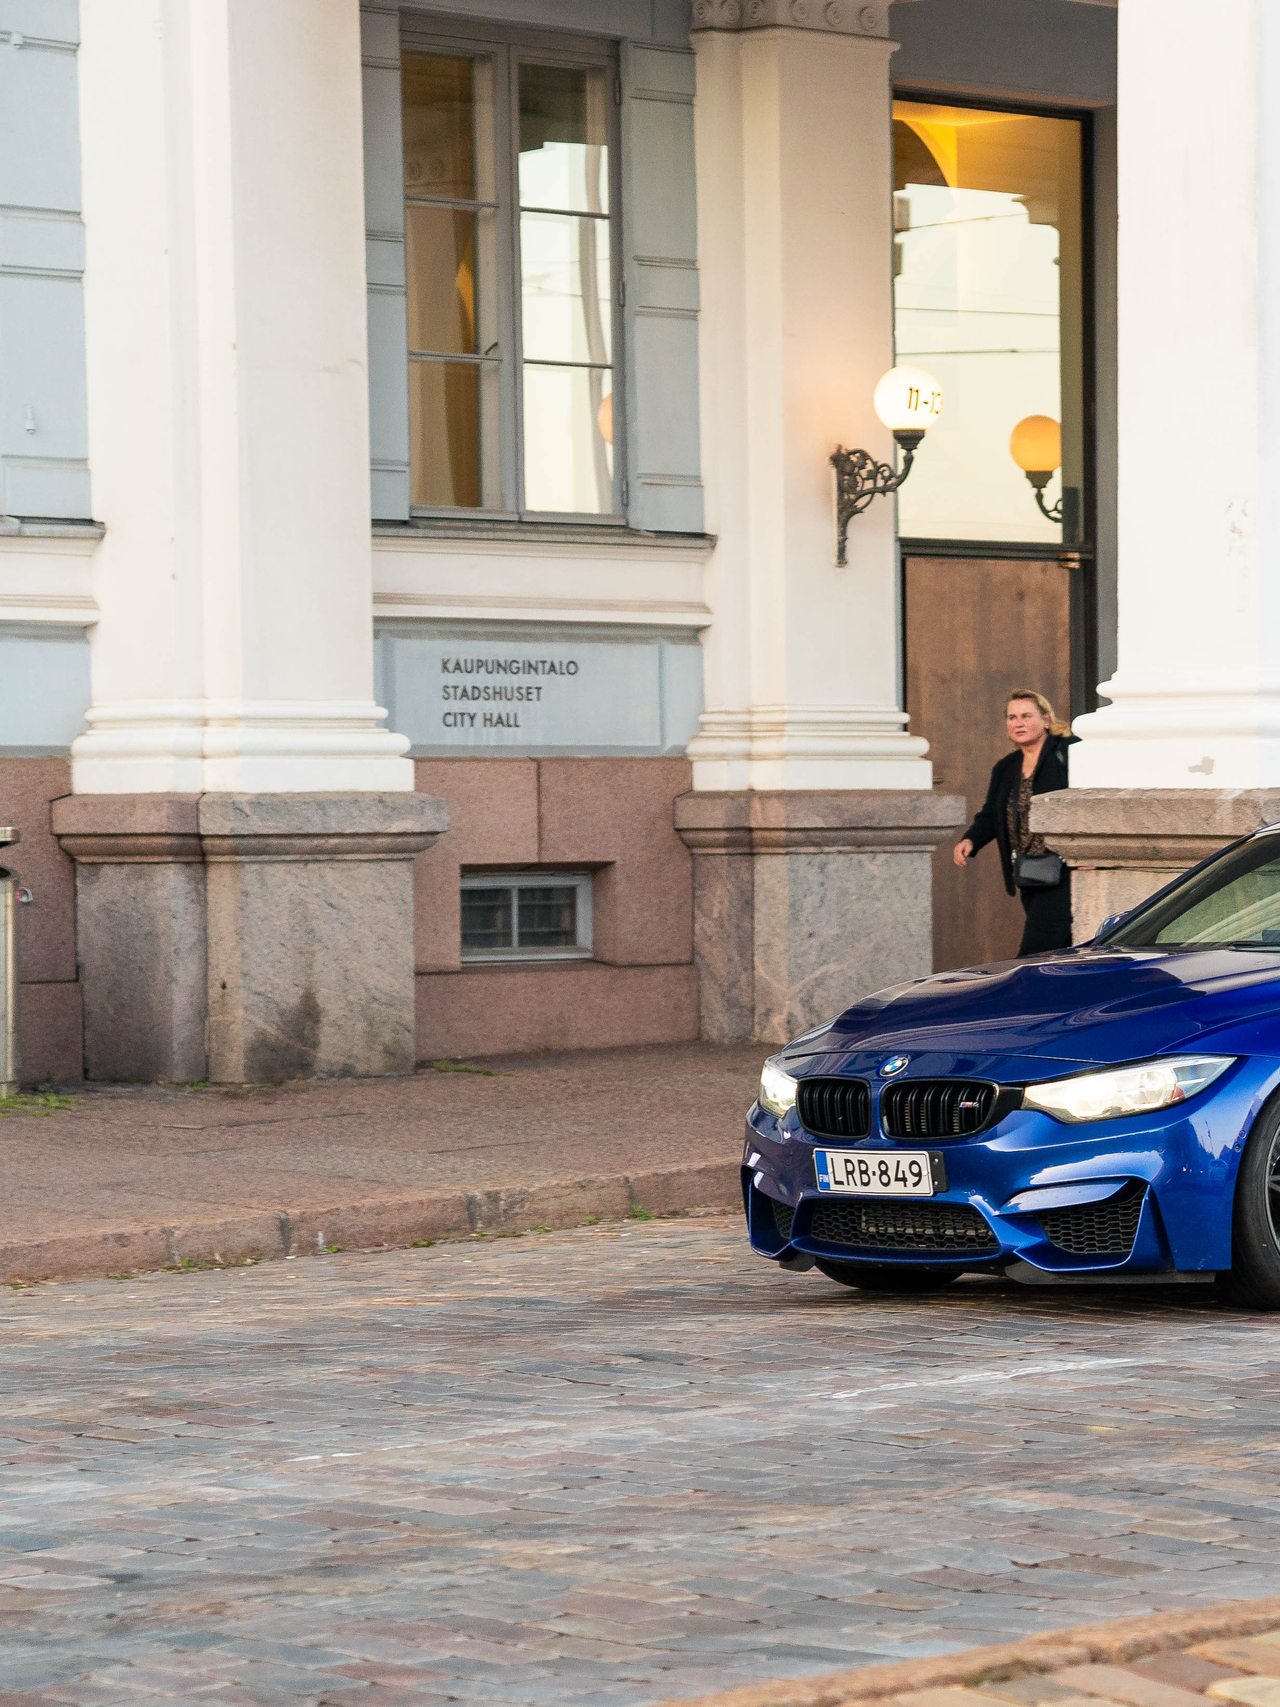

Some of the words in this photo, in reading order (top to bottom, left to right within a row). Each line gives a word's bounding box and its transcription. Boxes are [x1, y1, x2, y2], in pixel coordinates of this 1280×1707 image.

[441, 658, 579, 675] KAUPUNGINTALO
[442, 685, 543, 702] STADSHUSET
[442, 712, 477, 728] CITY
[483, 713, 520, 728] HALL
[831, 1158, 922, 1187] LRB-849
